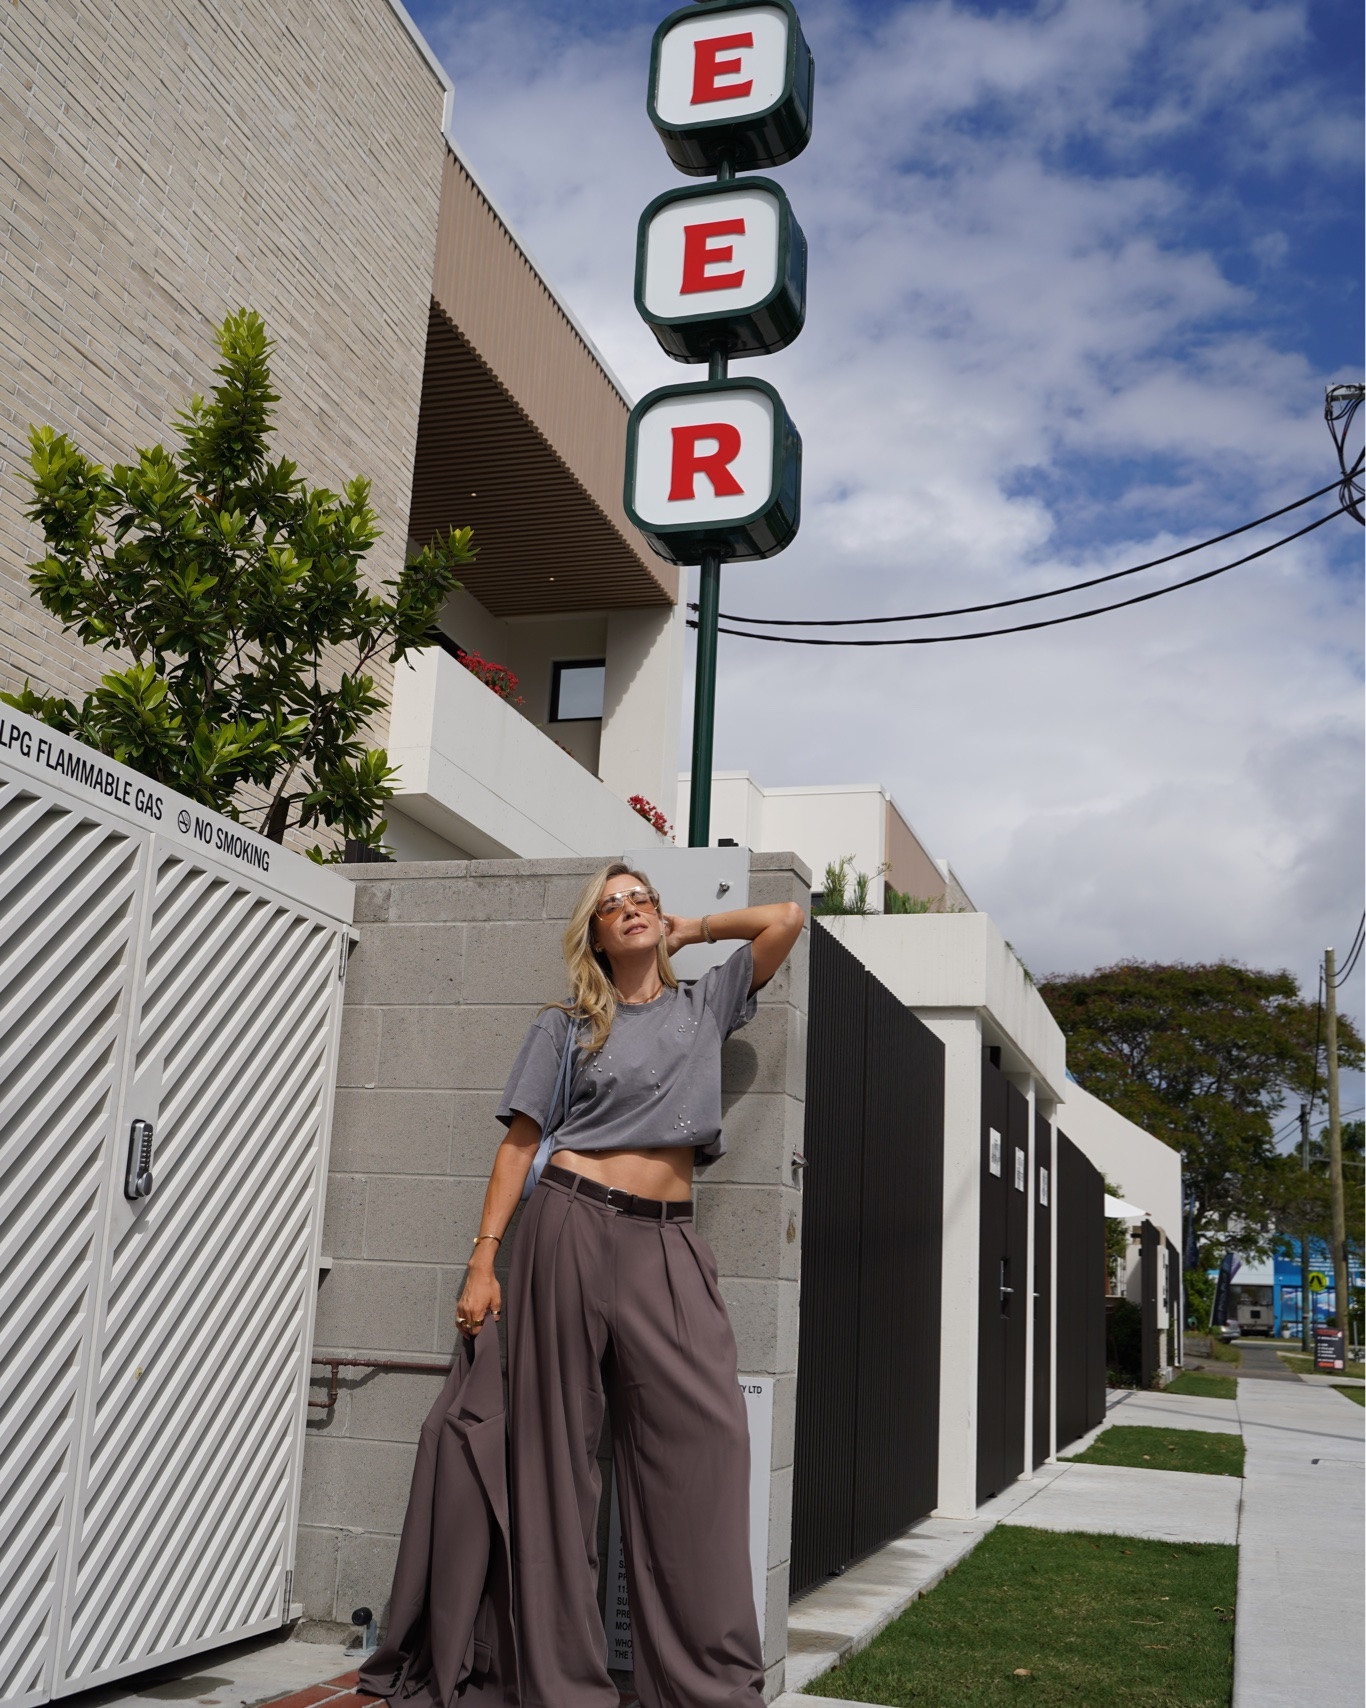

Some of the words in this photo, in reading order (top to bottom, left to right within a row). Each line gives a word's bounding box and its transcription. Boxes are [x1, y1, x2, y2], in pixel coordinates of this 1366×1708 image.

[0, 719, 33, 758] LPG
[36, 738, 133, 806] FLAMMABLE
[135, 788, 163, 821] GAS
[194, 816, 213, 845] NO
[215, 827, 270, 873] SMOKING
[748, 1385, 763, 1394] LTD
[614, 1649, 629, 1660] THE
